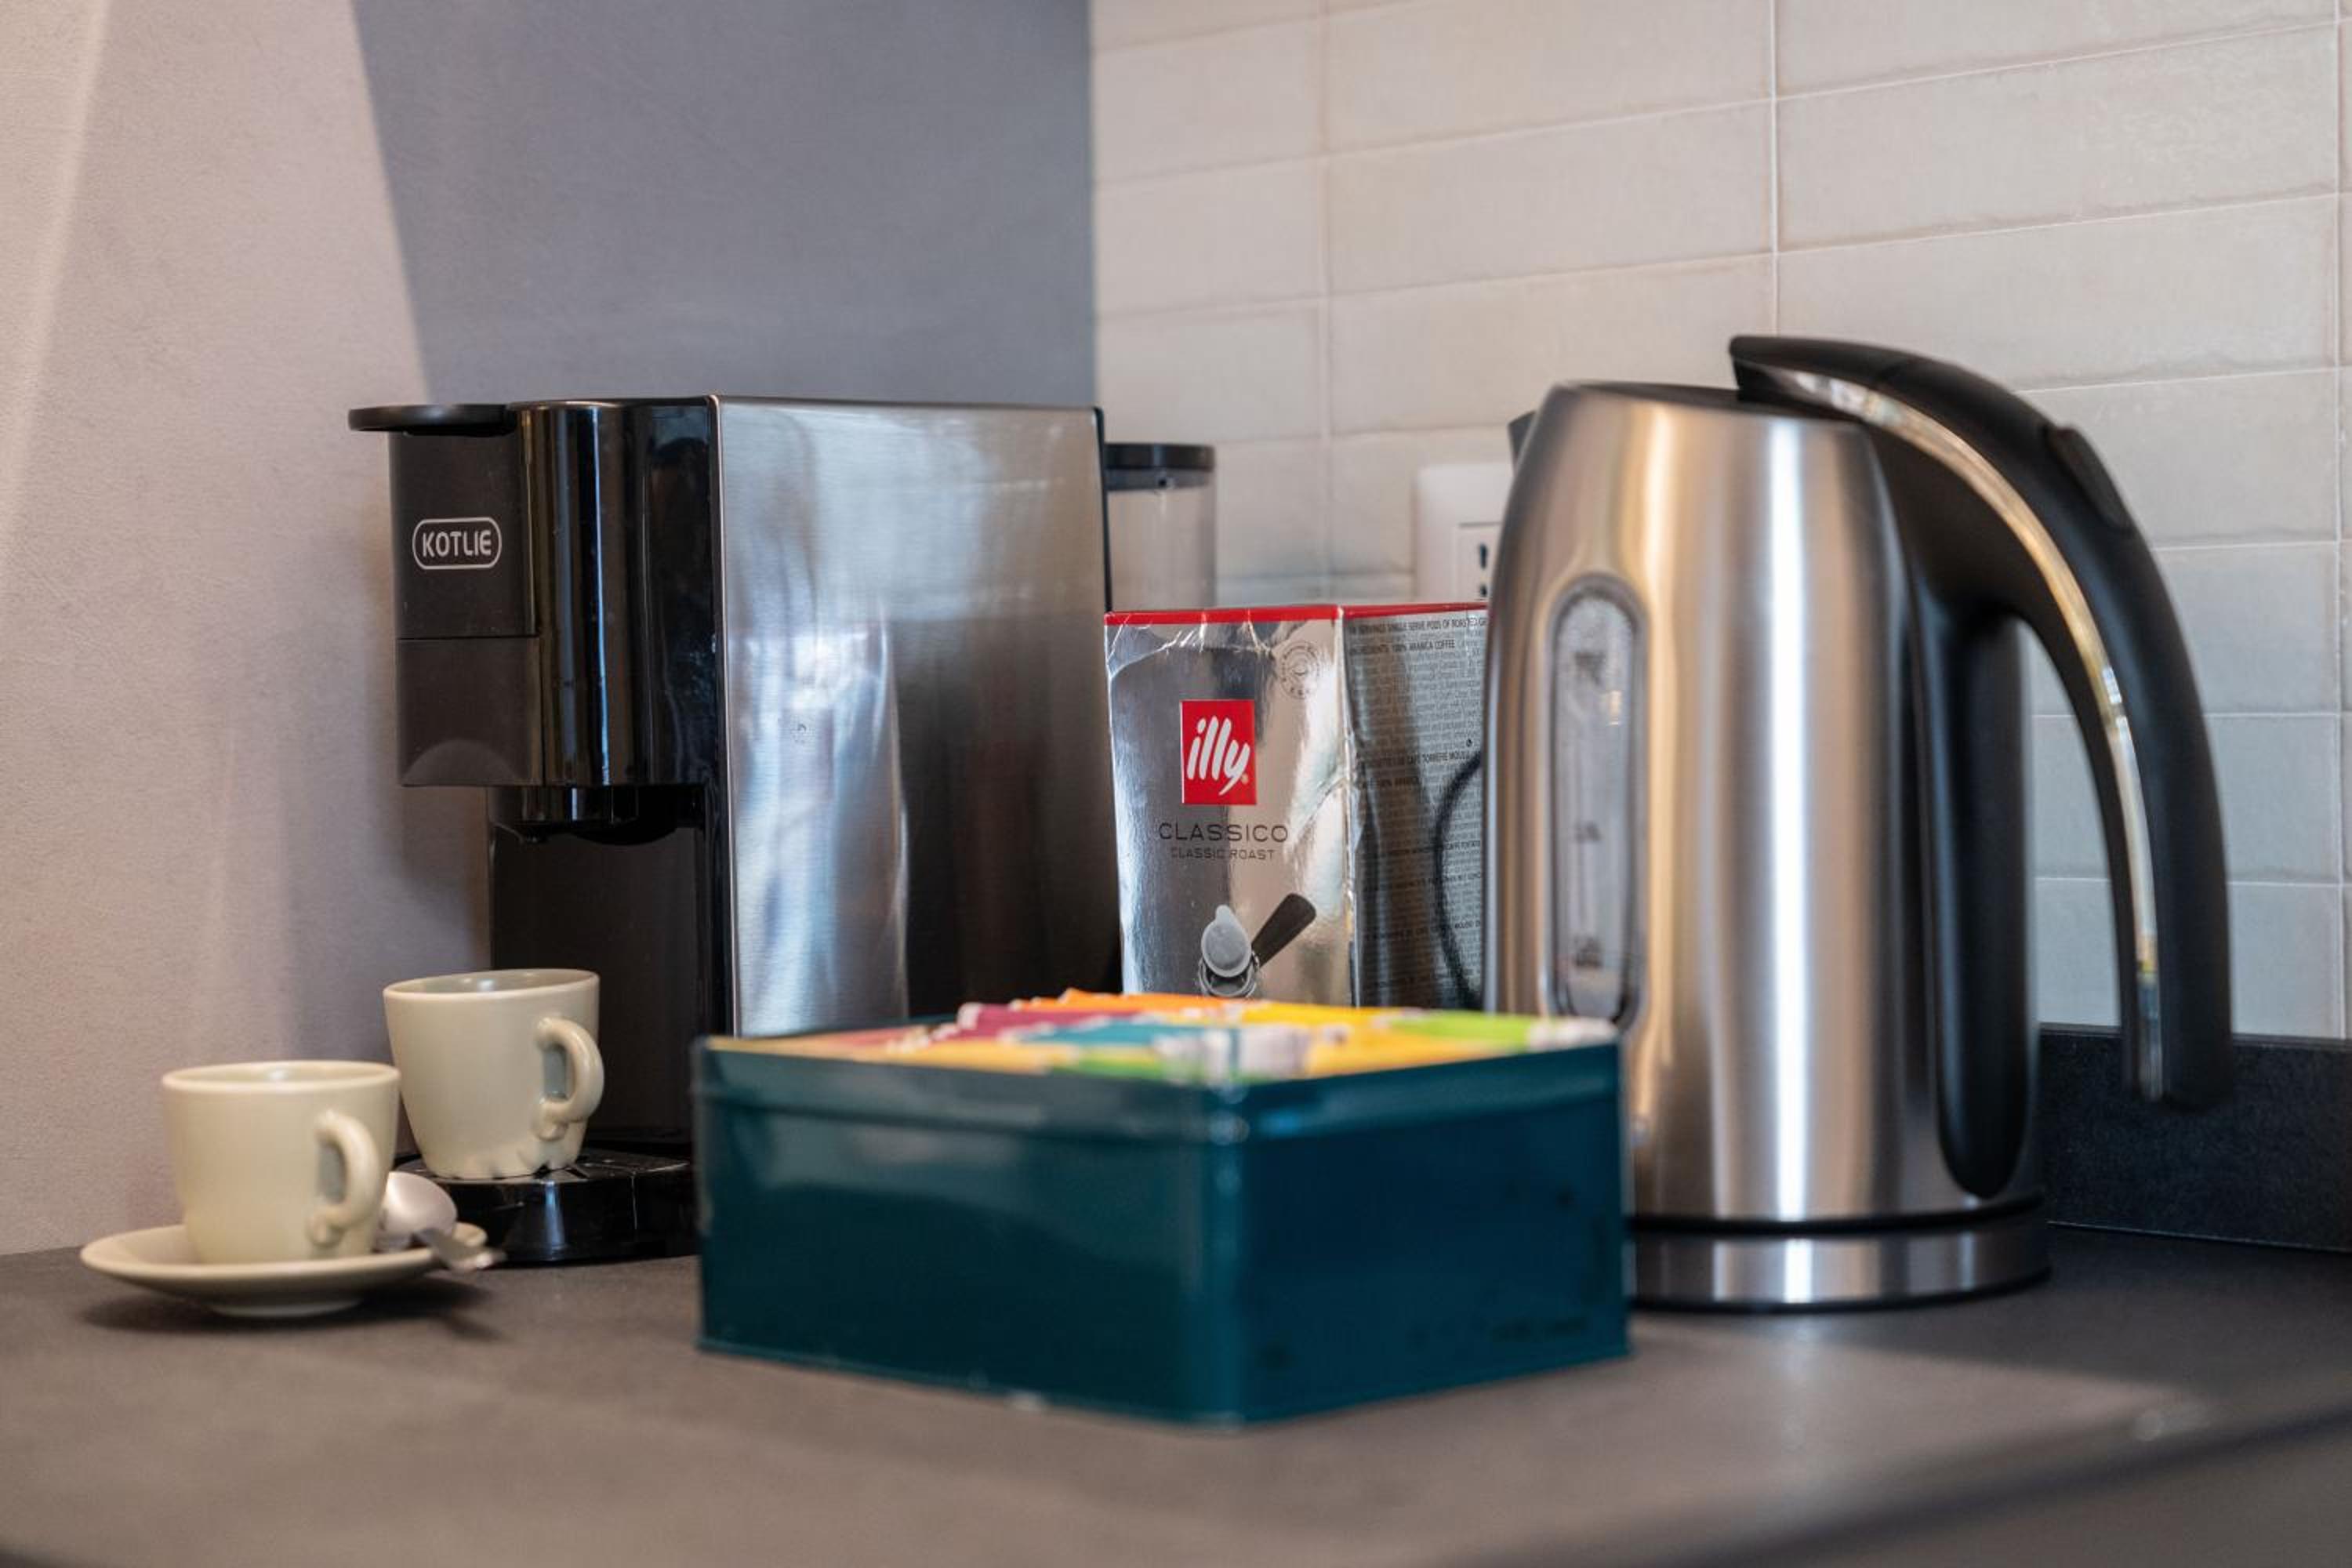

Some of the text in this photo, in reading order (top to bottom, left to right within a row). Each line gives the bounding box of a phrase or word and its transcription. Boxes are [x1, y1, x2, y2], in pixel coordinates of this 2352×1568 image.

[422, 530, 492, 557] KOTLIE
[1426, 620, 1442, 630] PODS
[1443, 619, 1450, 628] OF
[1409, 641, 1434, 651] ARABICA
[1435, 639, 1456, 649] COFFEE
[1186, 716, 1250, 797] illy
[1158, 822, 1288, 843] CLASSICO
[1171, 848, 1276, 861] CLASSIC ROAST
